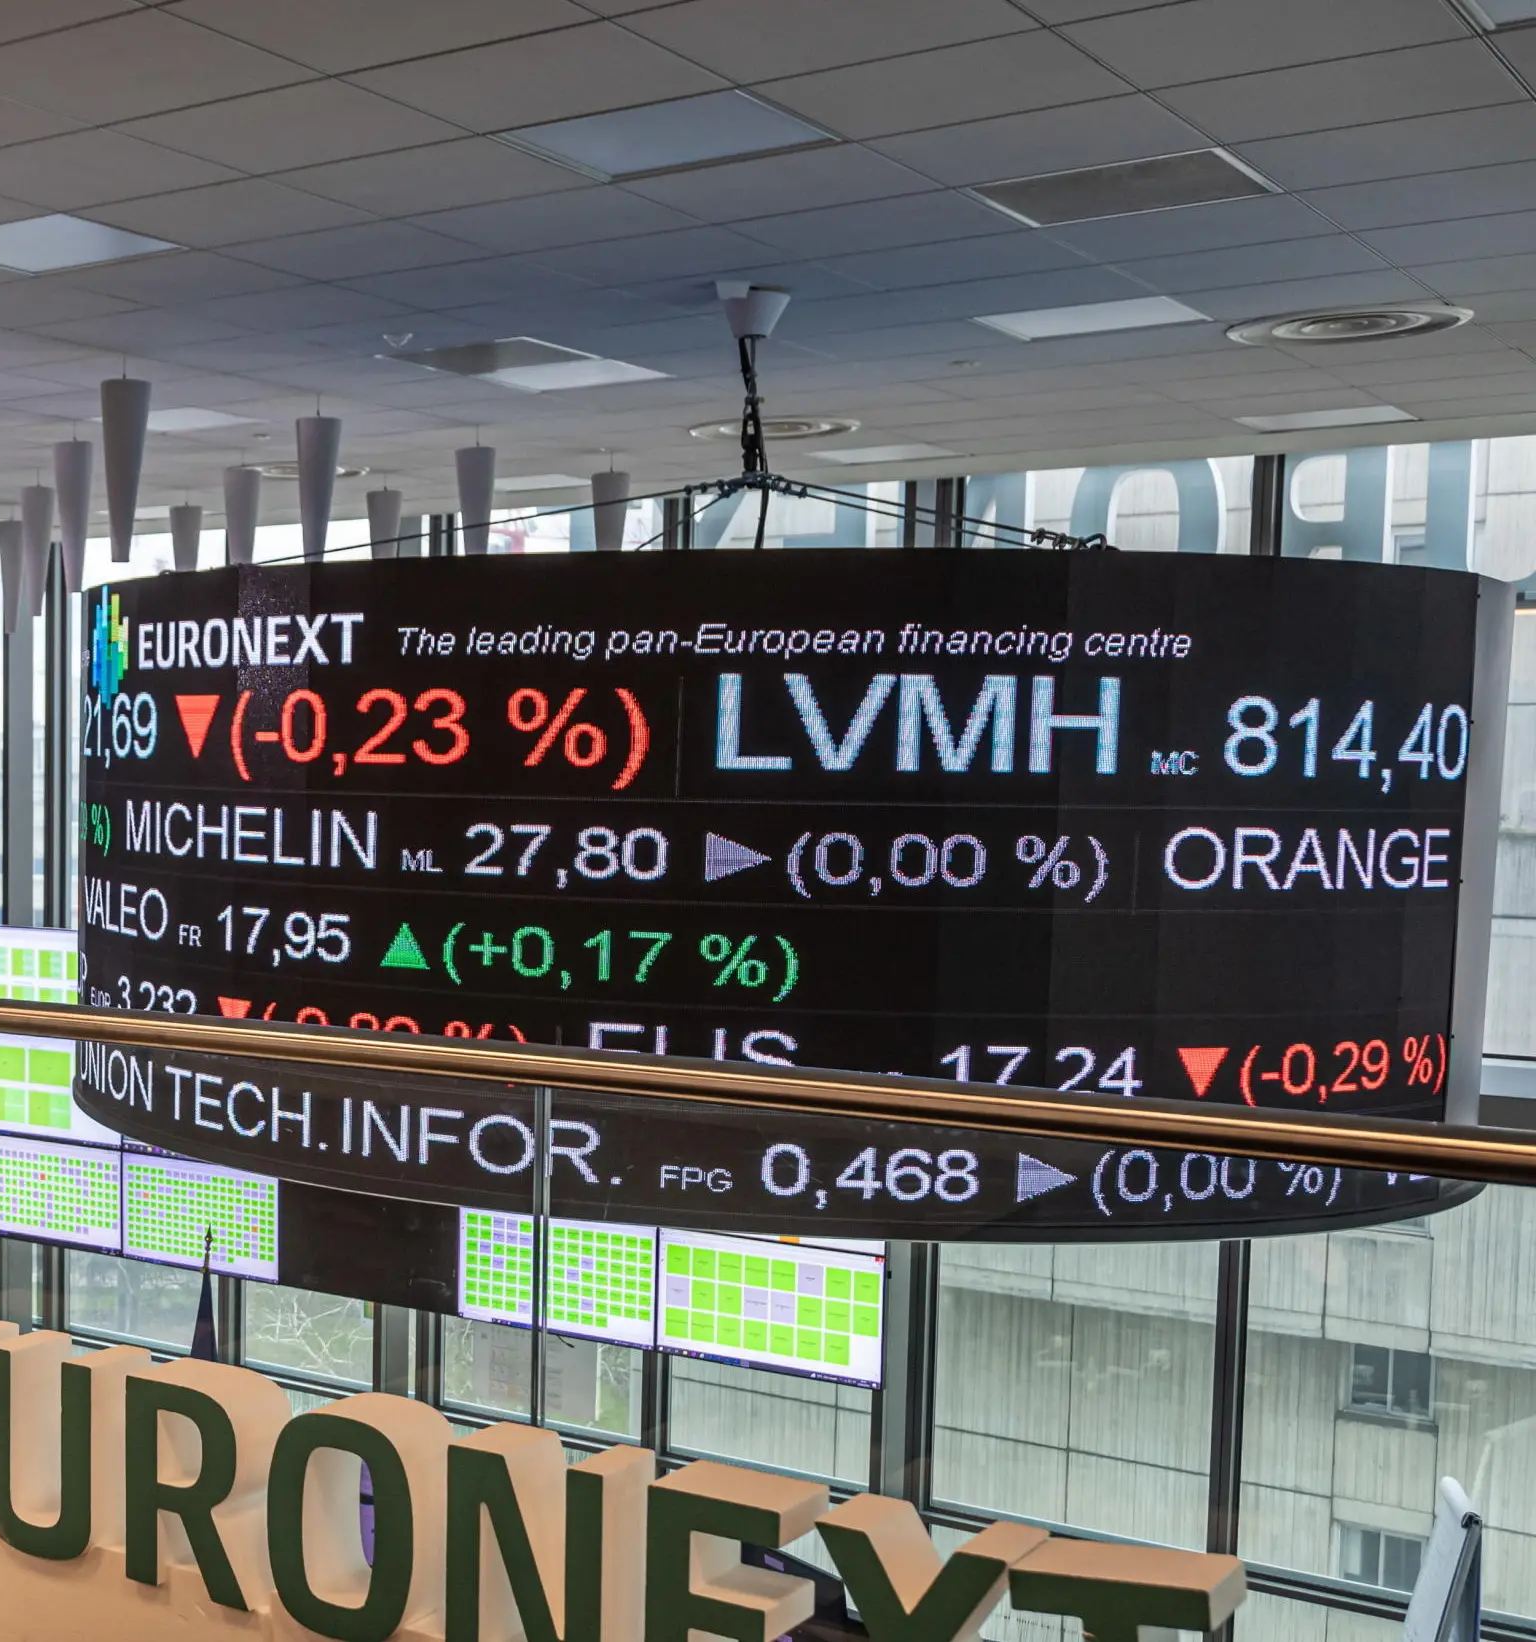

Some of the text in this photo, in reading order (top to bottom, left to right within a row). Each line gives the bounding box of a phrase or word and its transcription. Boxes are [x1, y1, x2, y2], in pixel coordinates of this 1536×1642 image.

[138, 612, 364, 670] EURONEXT
[397, 623, 1192, 663] The leading pan-European financing centre
[230, 688, 470, 782] (-0,23
[507, 687, 650, 790] %)
[716, 672, 1121, 775] LVMH
[1150, 750, 1200, 776] MC
[1223, 695, 1470, 797] 814,40
[126, 799, 378, 869] MICHELIN
[401, 848, 444, 873] ML
[464, 822, 667, 889] 27,80
[787, 831, 987, 899] (0,00
[1015, 835, 1110, 903] %)
[1164, 826, 1450, 891] ORANGE
[83, 875, 799, 1003] VALEO FR 17,95 (+0,17 %)
[1239, 1039, 1390, 1109] (-0,29
[1402, 1033, 1446, 1094] %)
[79, 1041, 154, 1112] UNION
[660, 1164, 733, 1193] FPG
[761, 1143, 980, 1210] 0,468
